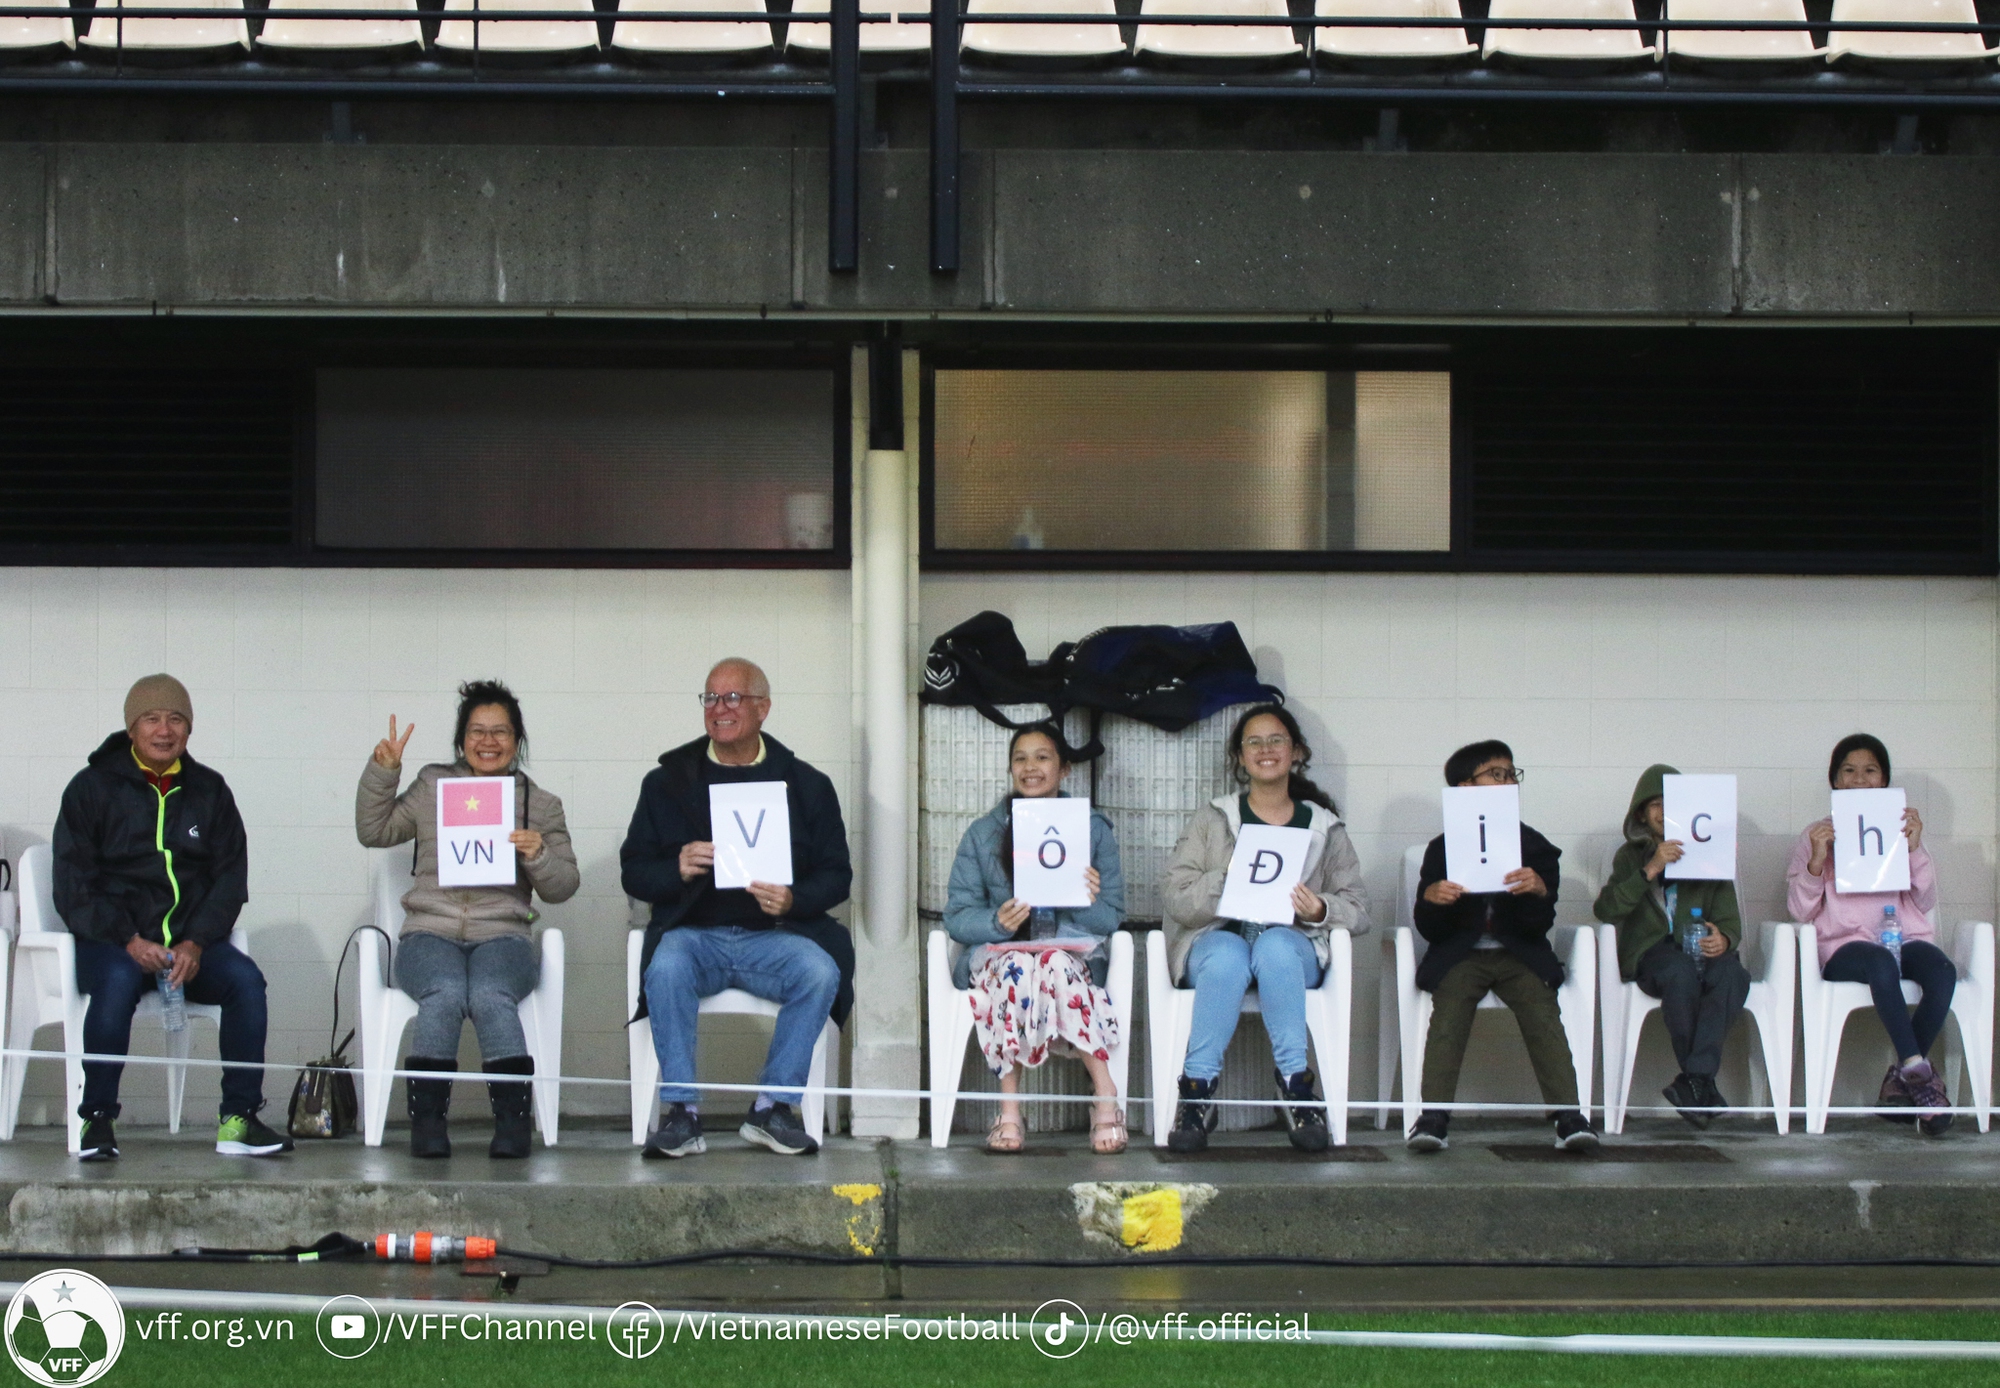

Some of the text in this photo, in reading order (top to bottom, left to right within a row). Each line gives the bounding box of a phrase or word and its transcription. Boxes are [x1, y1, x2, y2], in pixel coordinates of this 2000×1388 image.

[732, 808, 767, 848] V
[1037, 825, 1067, 870] Ô
[1857, 814, 1884, 857] h
[450, 839, 494, 865] VN
[1248, 849, 1284, 885] Đ
